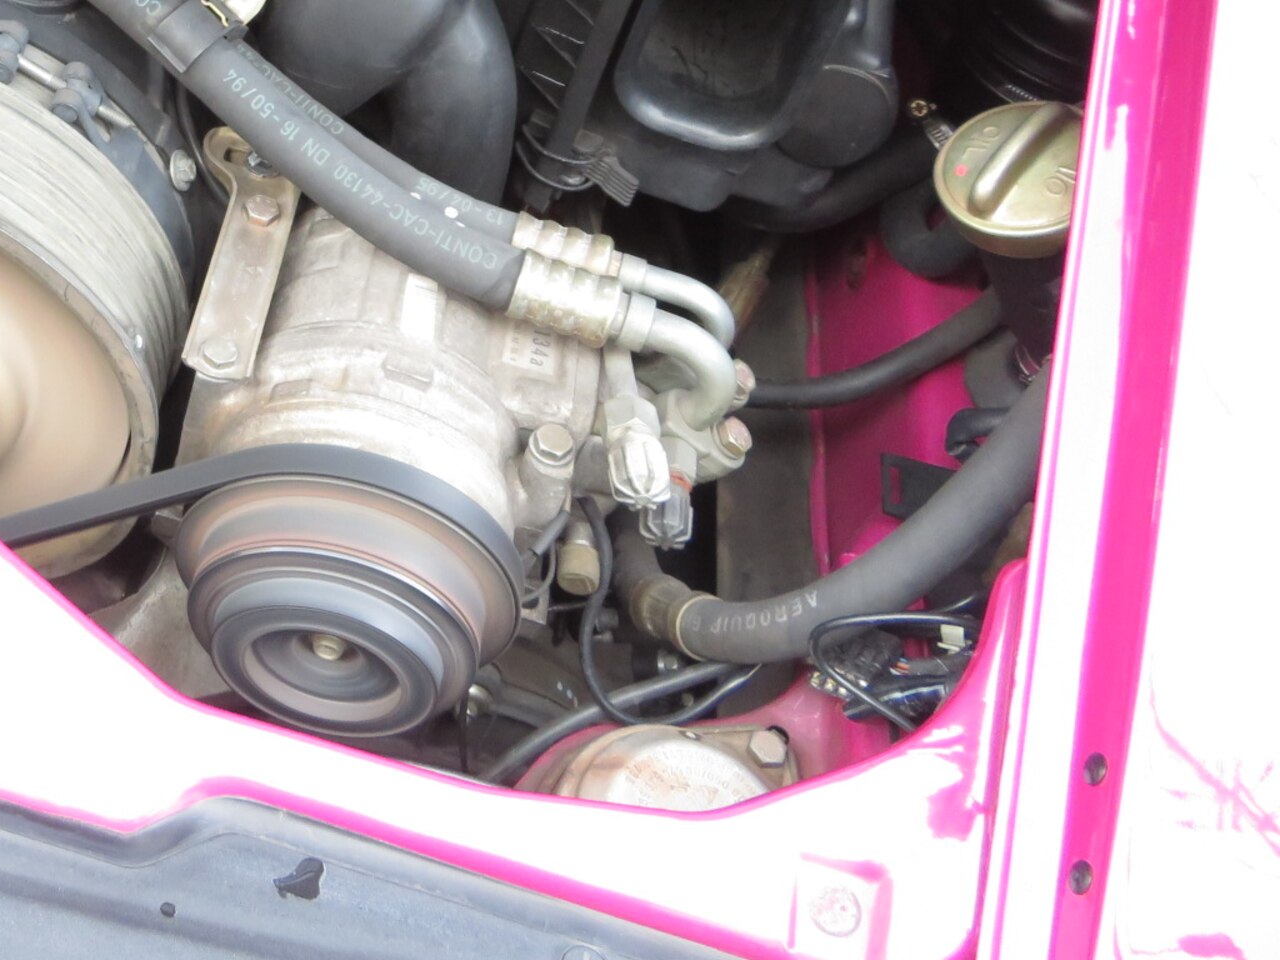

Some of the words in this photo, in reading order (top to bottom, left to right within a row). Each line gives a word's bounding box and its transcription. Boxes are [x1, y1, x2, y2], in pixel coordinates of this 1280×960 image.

[301, 137, 328, 167] DN
[962, 126, 1001, 159] OIL
[710, 590, 818, 634] AEROQUIP
